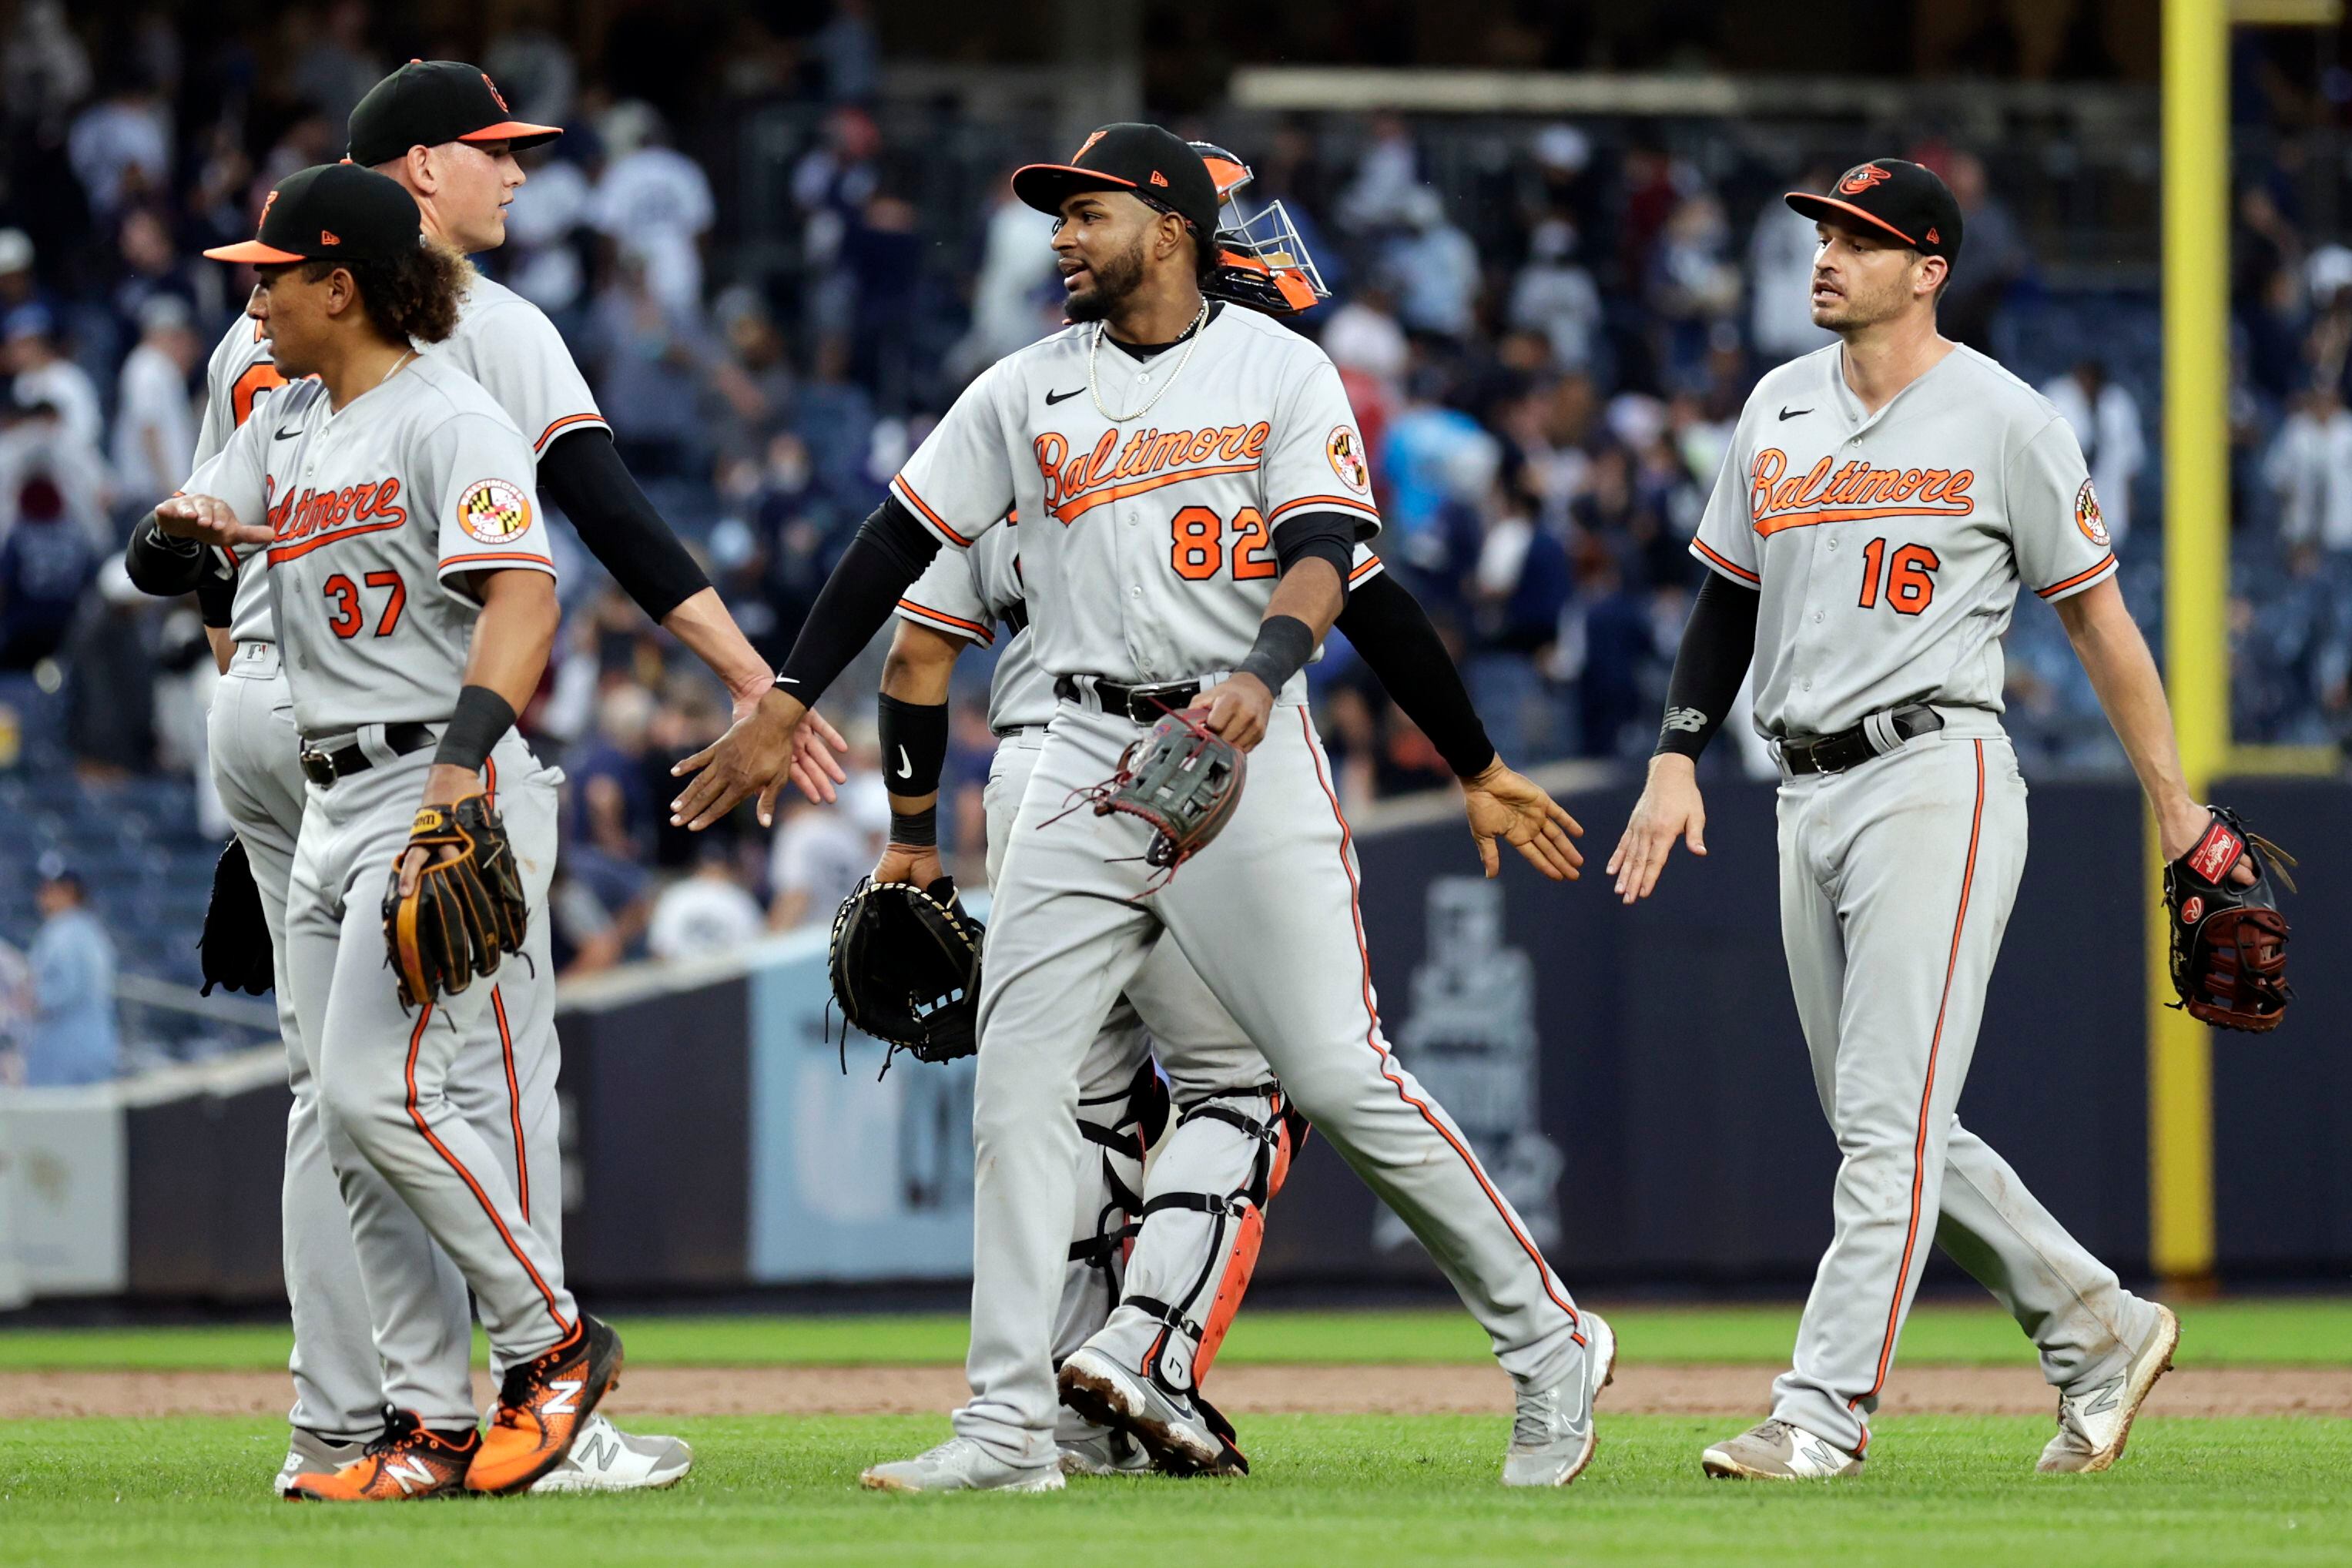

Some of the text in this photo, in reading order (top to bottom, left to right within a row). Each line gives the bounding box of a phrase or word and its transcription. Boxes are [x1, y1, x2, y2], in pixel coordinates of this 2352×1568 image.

[461, 479, 524, 505] BALTIMORE
[1033, 420, 1271, 517] Baltimore
[1751, 447, 1974, 521] Baltimore
[1171, 505, 1278, 581] 82
[1858, 538, 1940, 615] 16
[323, 570, 407, 639] 37
